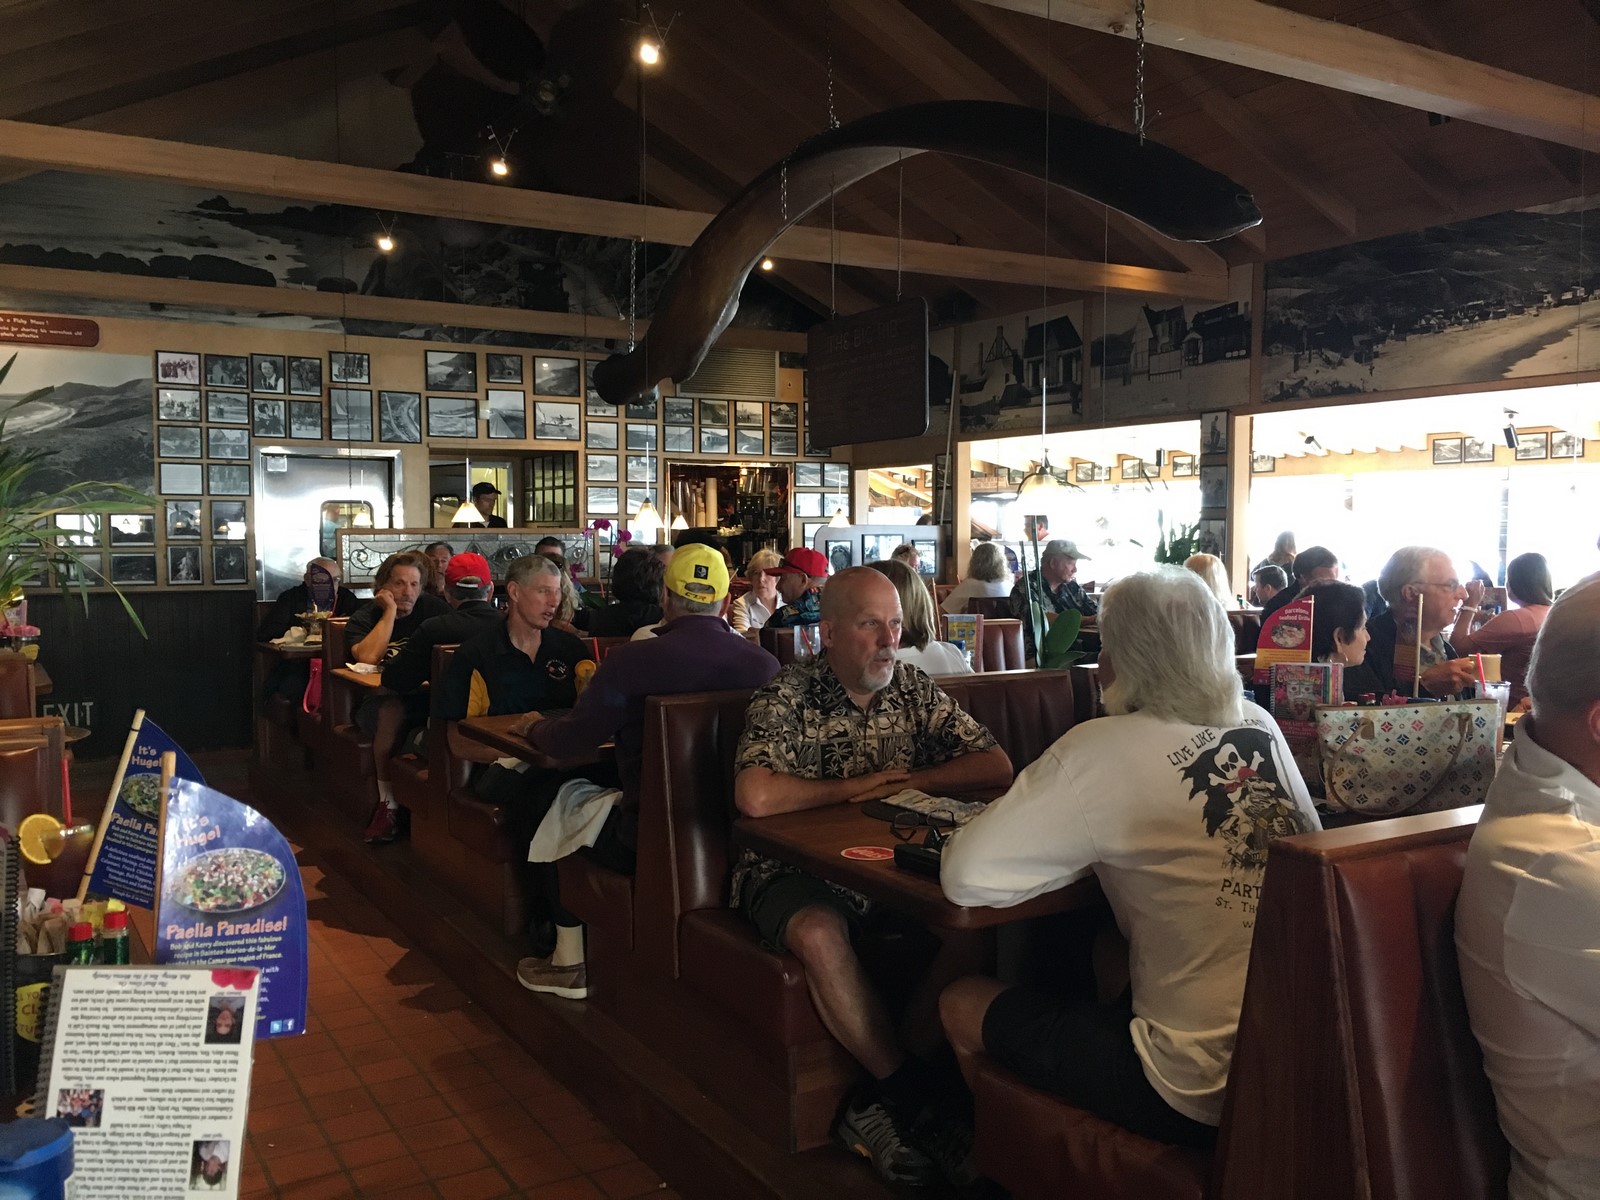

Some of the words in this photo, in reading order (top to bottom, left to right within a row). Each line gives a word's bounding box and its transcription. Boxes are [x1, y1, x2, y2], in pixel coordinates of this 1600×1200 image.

[43, 701, 94, 727] EXIT
[138, 745, 157, 756] It's
[1167, 745, 1194, 767] LIVE
[1191, 728, 1216, 750] LIKE
[111, 812, 142, 831] Paella
[1220, 878, 1263, 900] PART
[166, 922, 213, 941] Paella
[217, 915, 288, 937] Paradise!
